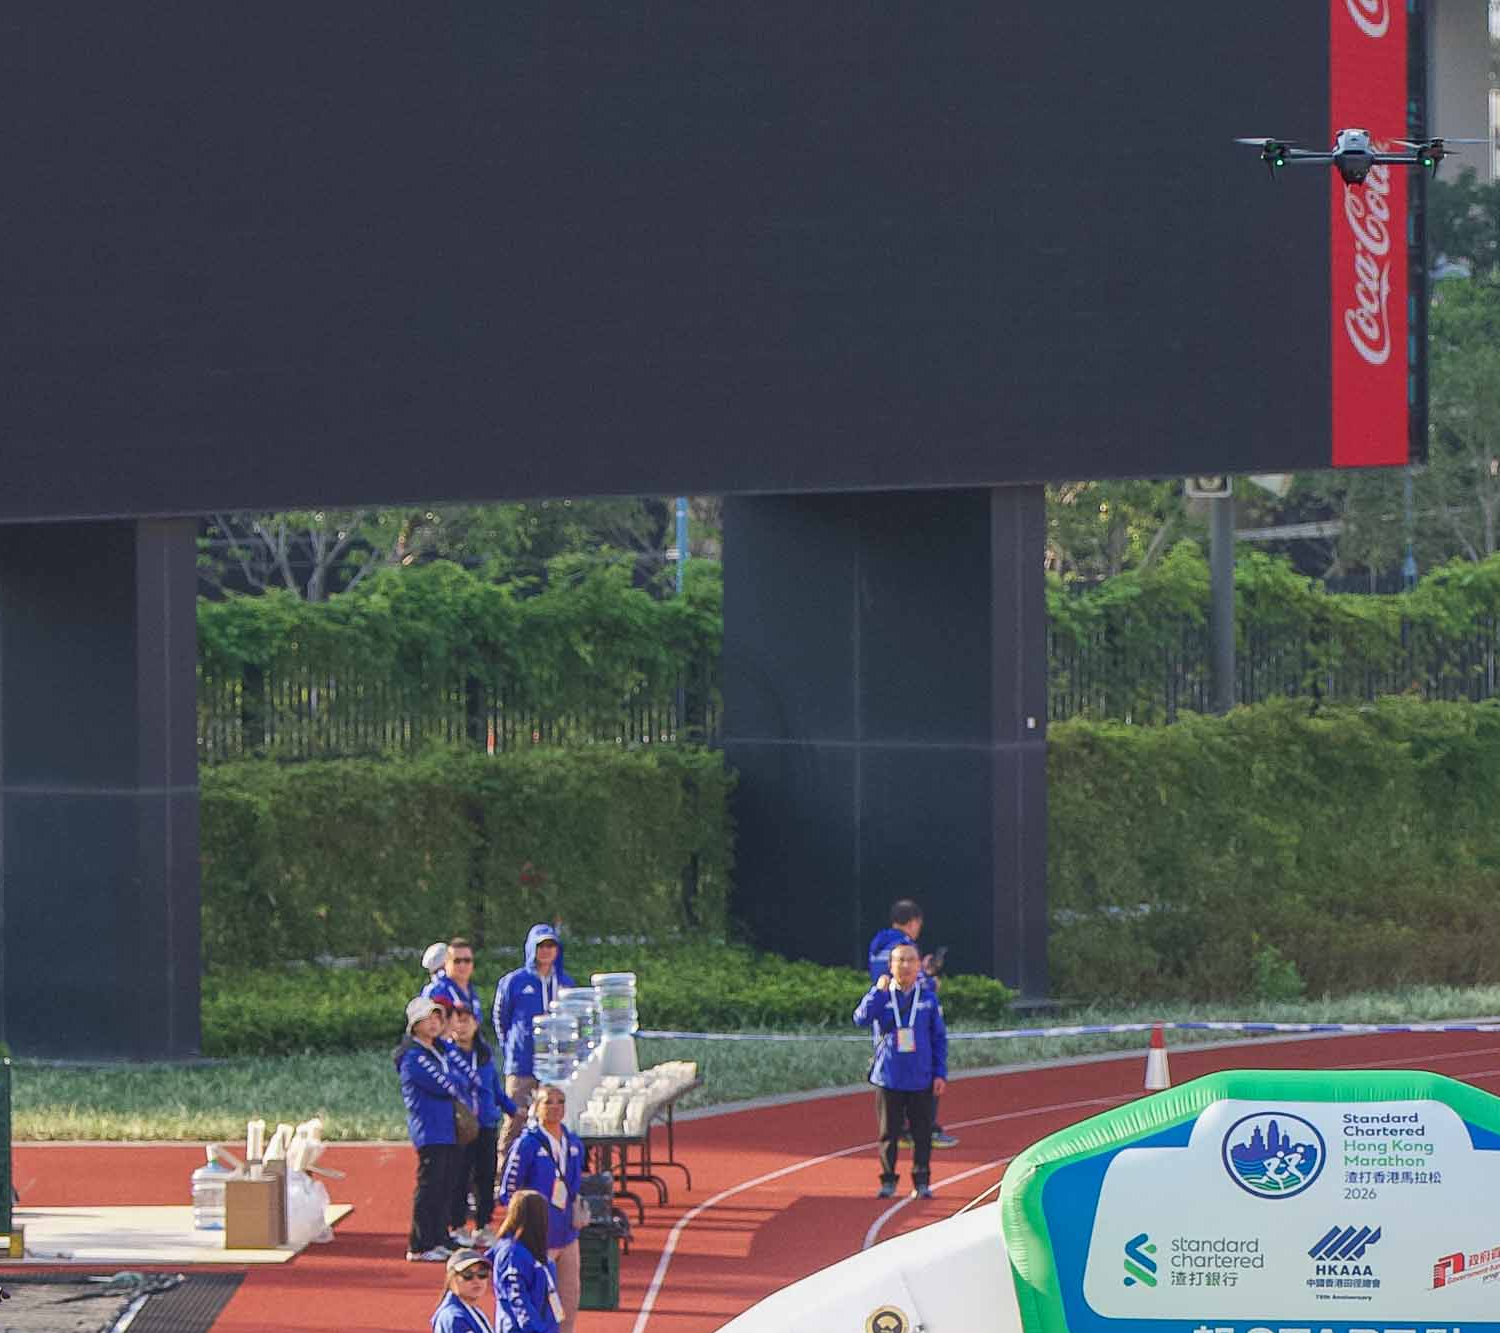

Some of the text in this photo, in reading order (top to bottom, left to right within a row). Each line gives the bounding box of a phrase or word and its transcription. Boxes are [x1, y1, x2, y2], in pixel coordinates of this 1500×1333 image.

[1343, 1113, 1419, 1124] Standard
[1343, 1125, 1425, 1137] Chartered
[1343, 1140, 1435, 1155] Hong Kong
[1343, 1155, 1425, 1167] Marathon
[1344, 1171, 1442, 1185] 渣打香港馬拉松
[1343, 1188, 1377, 1200] 2026
[1171, 1237, 1259, 1252] standard
[1171, 1253, 1264, 1270] chartered
[1316, 1265, 1373, 1276] HKAAA
[1171, 1271, 1239, 1287] 渣打銀行
